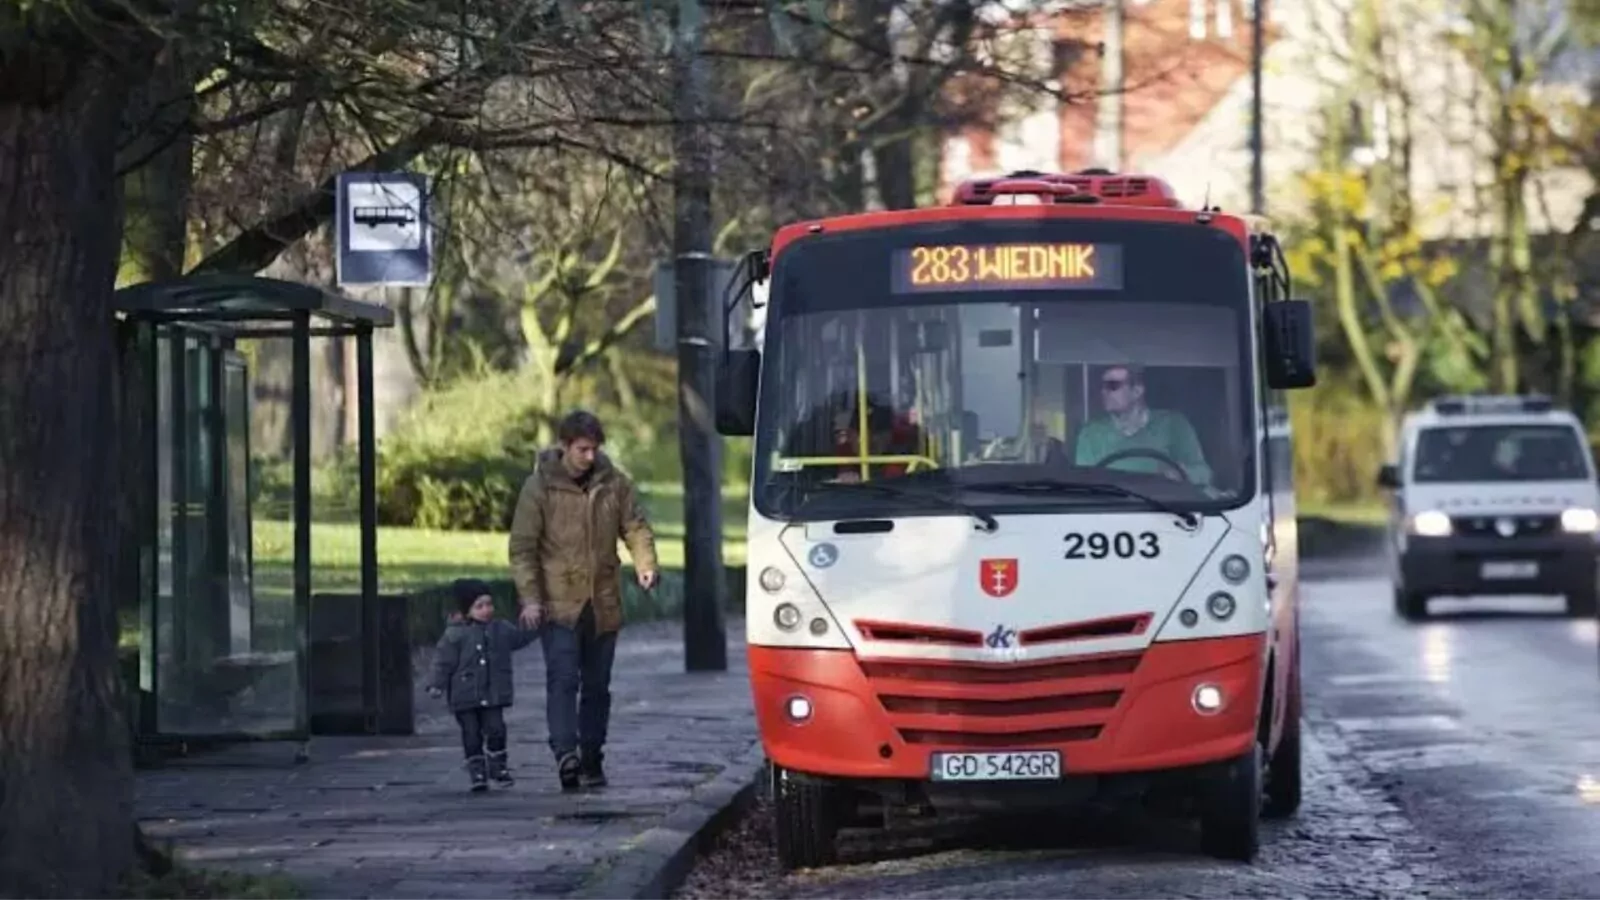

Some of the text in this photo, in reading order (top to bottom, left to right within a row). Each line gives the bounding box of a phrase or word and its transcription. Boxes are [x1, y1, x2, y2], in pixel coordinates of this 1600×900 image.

[912, 243, 1095, 284] 283 WIEDNIK
[1063, 531, 1160, 559] 2903
[946, 755, 978, 776] GD
[986, 753, 1056, 776] 542GR
